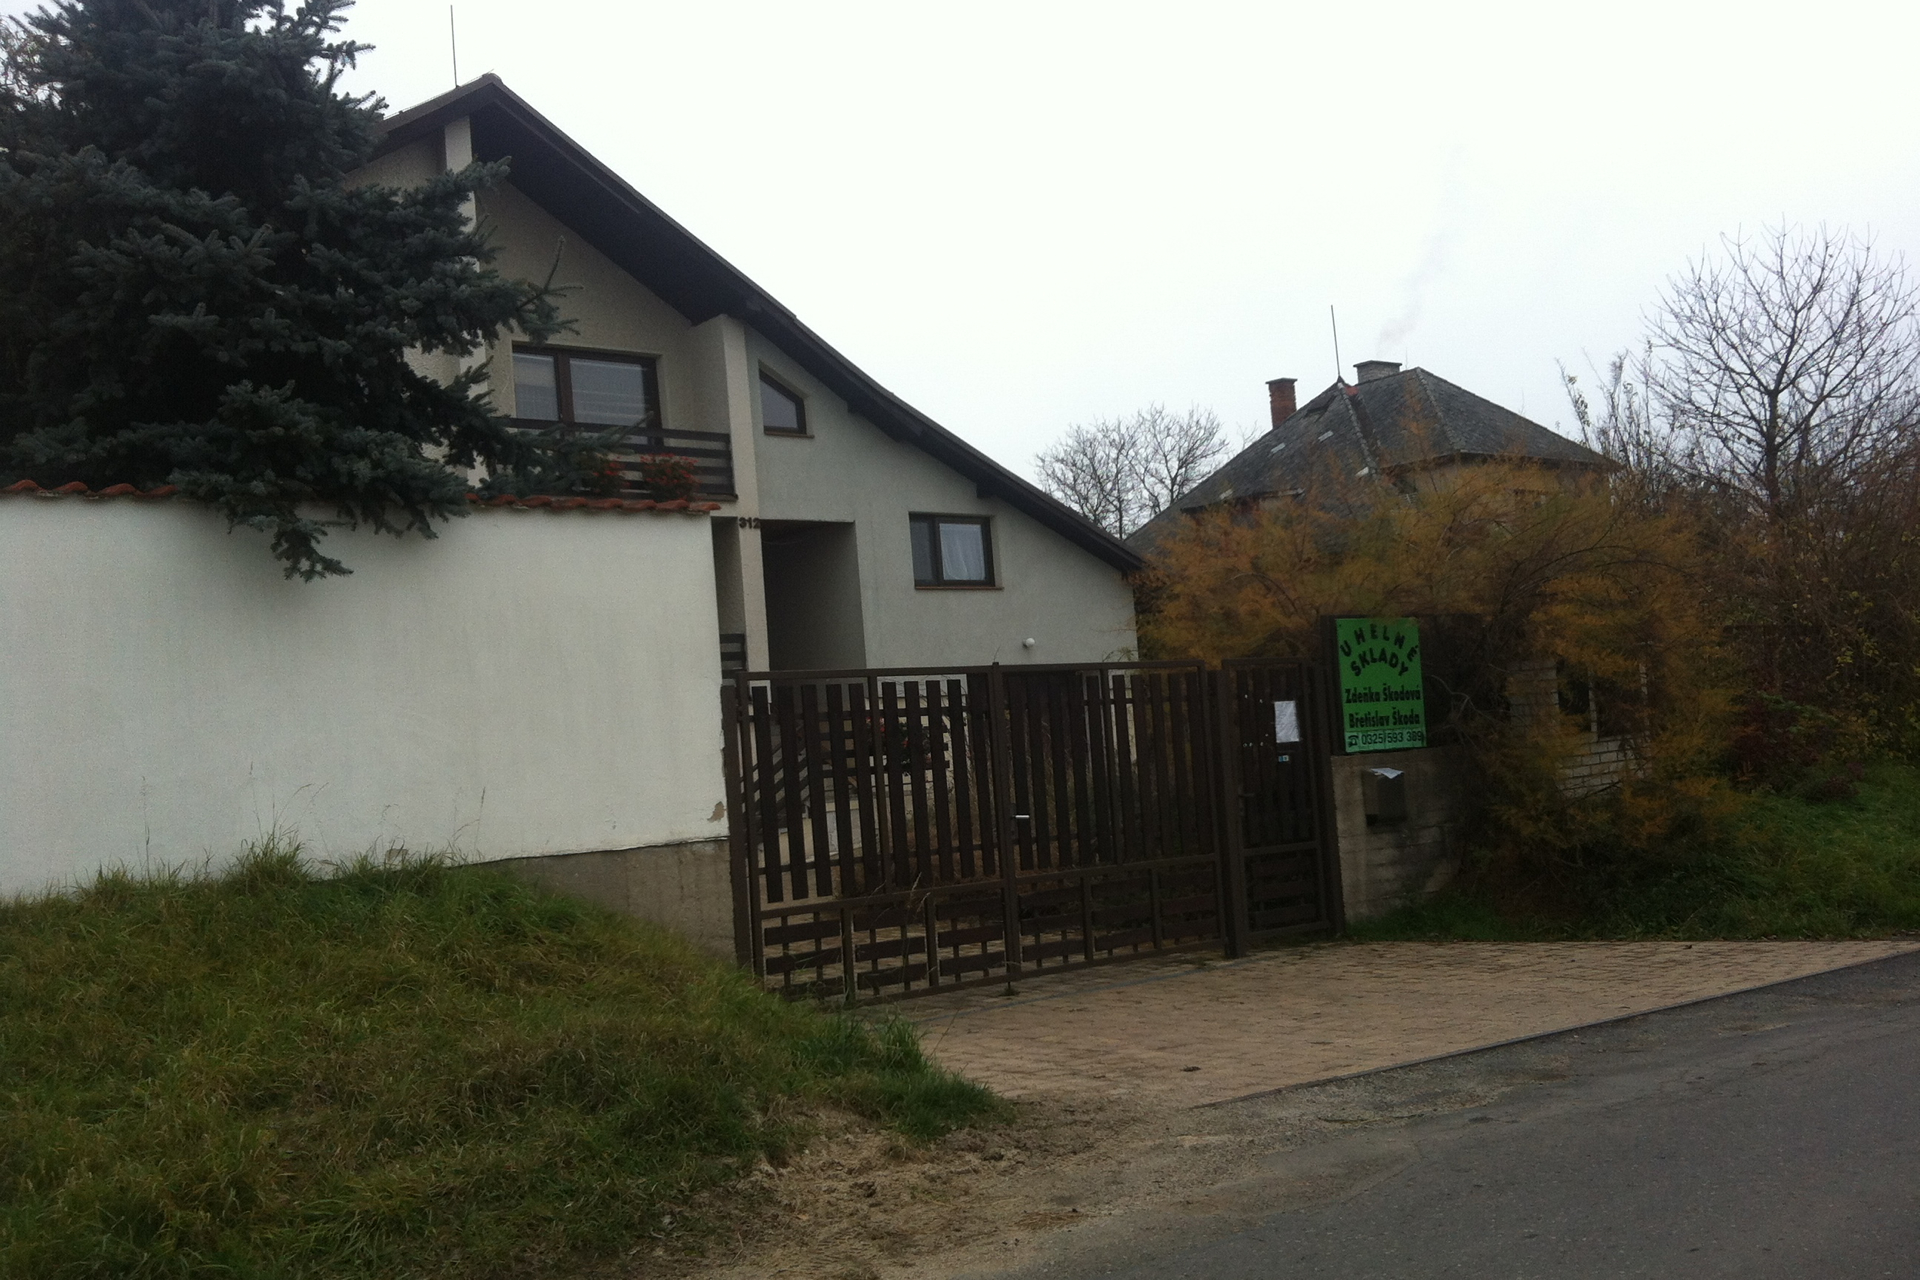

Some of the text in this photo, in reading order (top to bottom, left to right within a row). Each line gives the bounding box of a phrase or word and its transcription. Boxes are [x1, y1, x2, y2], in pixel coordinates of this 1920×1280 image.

[739, 517, 760, 529] 312
[1340, 624, 1419, 661] UHELNÉ
[1351, 647, 1409, 676] SKLADY
[1345, 683, 1421, 704] Zdeňka Škodová
[1349, 707, 1420, 728] Břetislav Škoda
